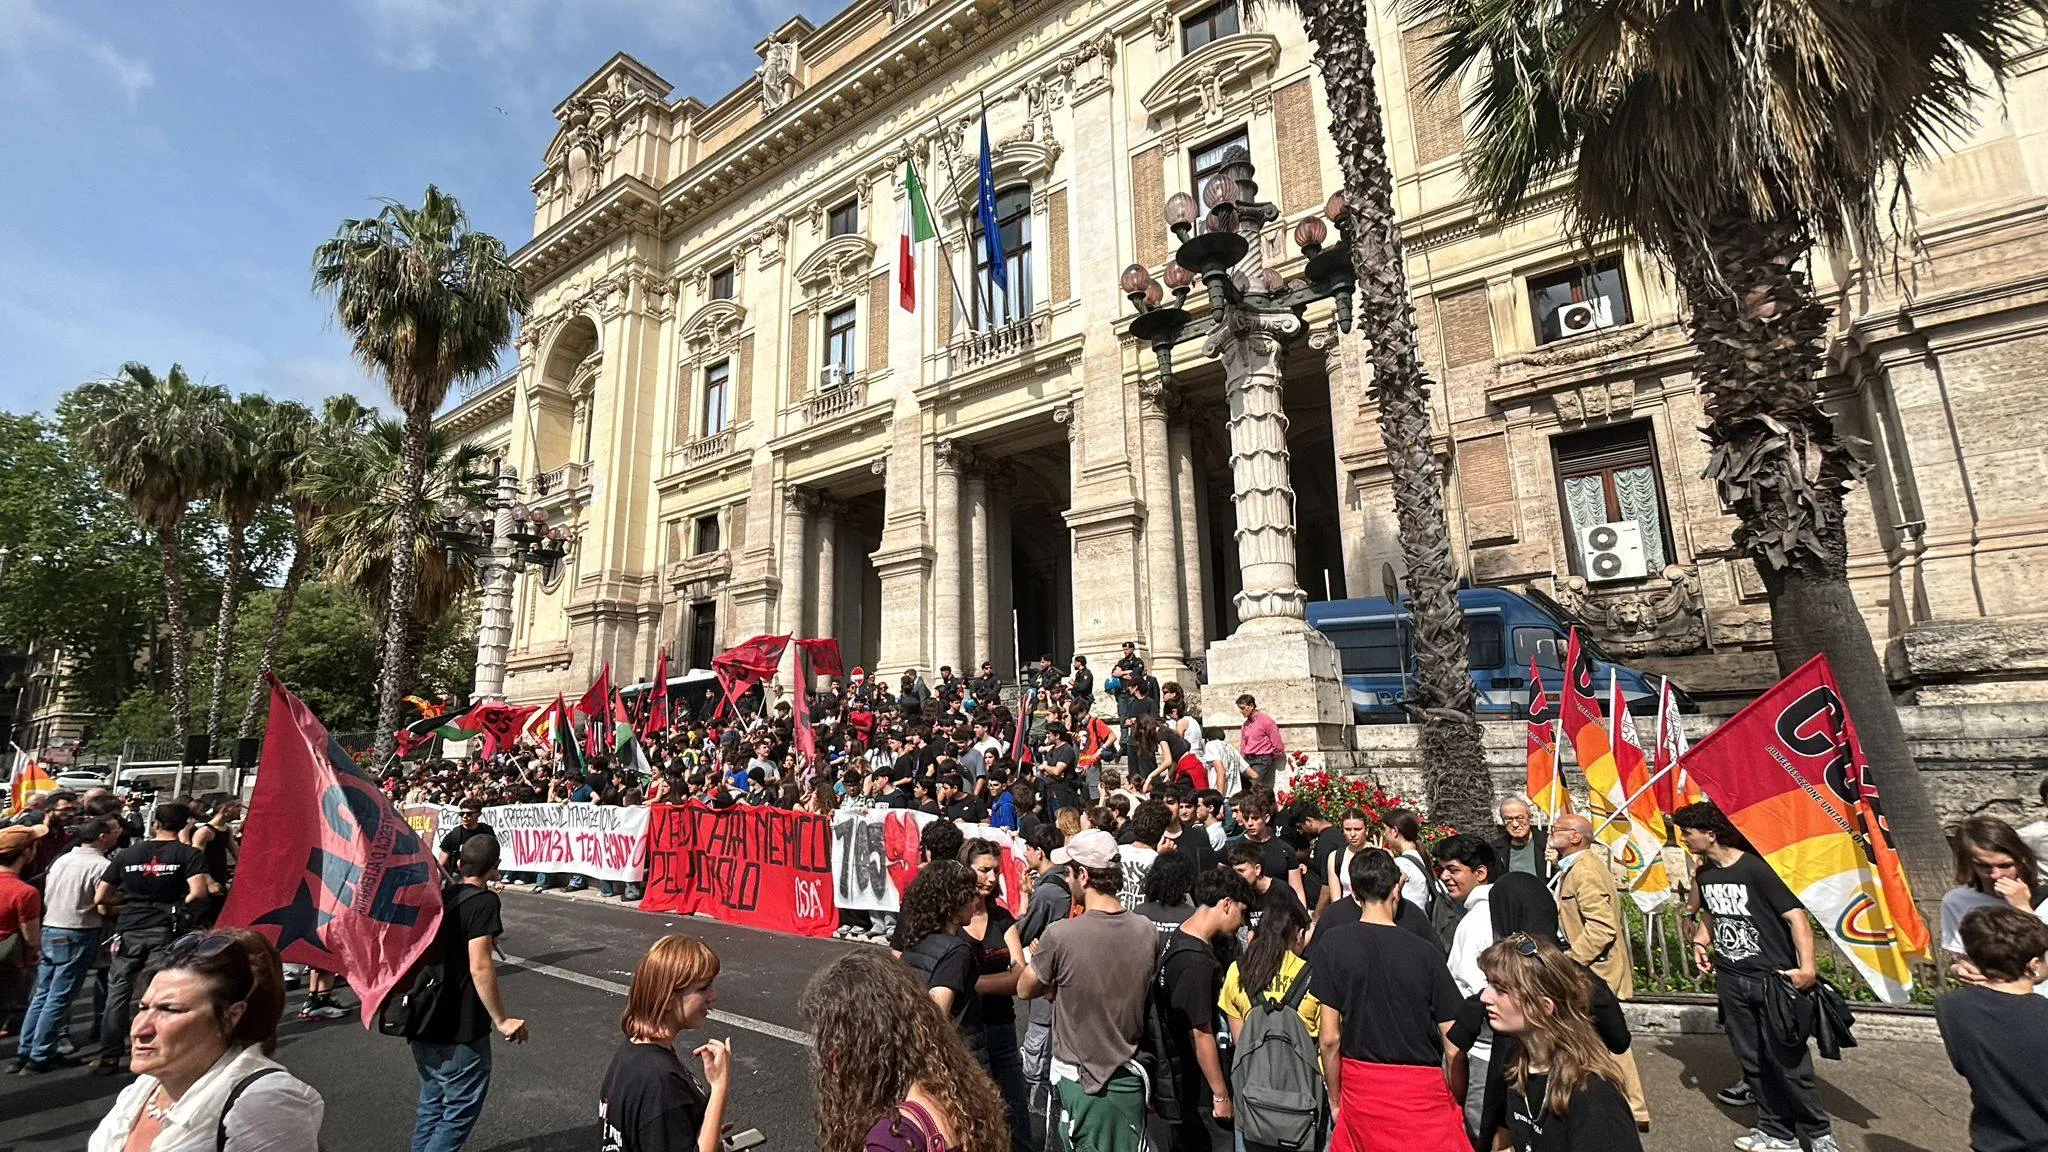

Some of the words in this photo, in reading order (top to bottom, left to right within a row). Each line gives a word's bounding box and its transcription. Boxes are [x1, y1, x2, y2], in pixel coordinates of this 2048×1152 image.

[882, 82, 957, 136] DELLA
[1766, 744, 1823, 803] CONFEDERAZIONE
[1820, 800, 1855, 835] UNITARIA
[755, 811, 832, 873] NEMICO
[795, 876, 824, 919] OSA
